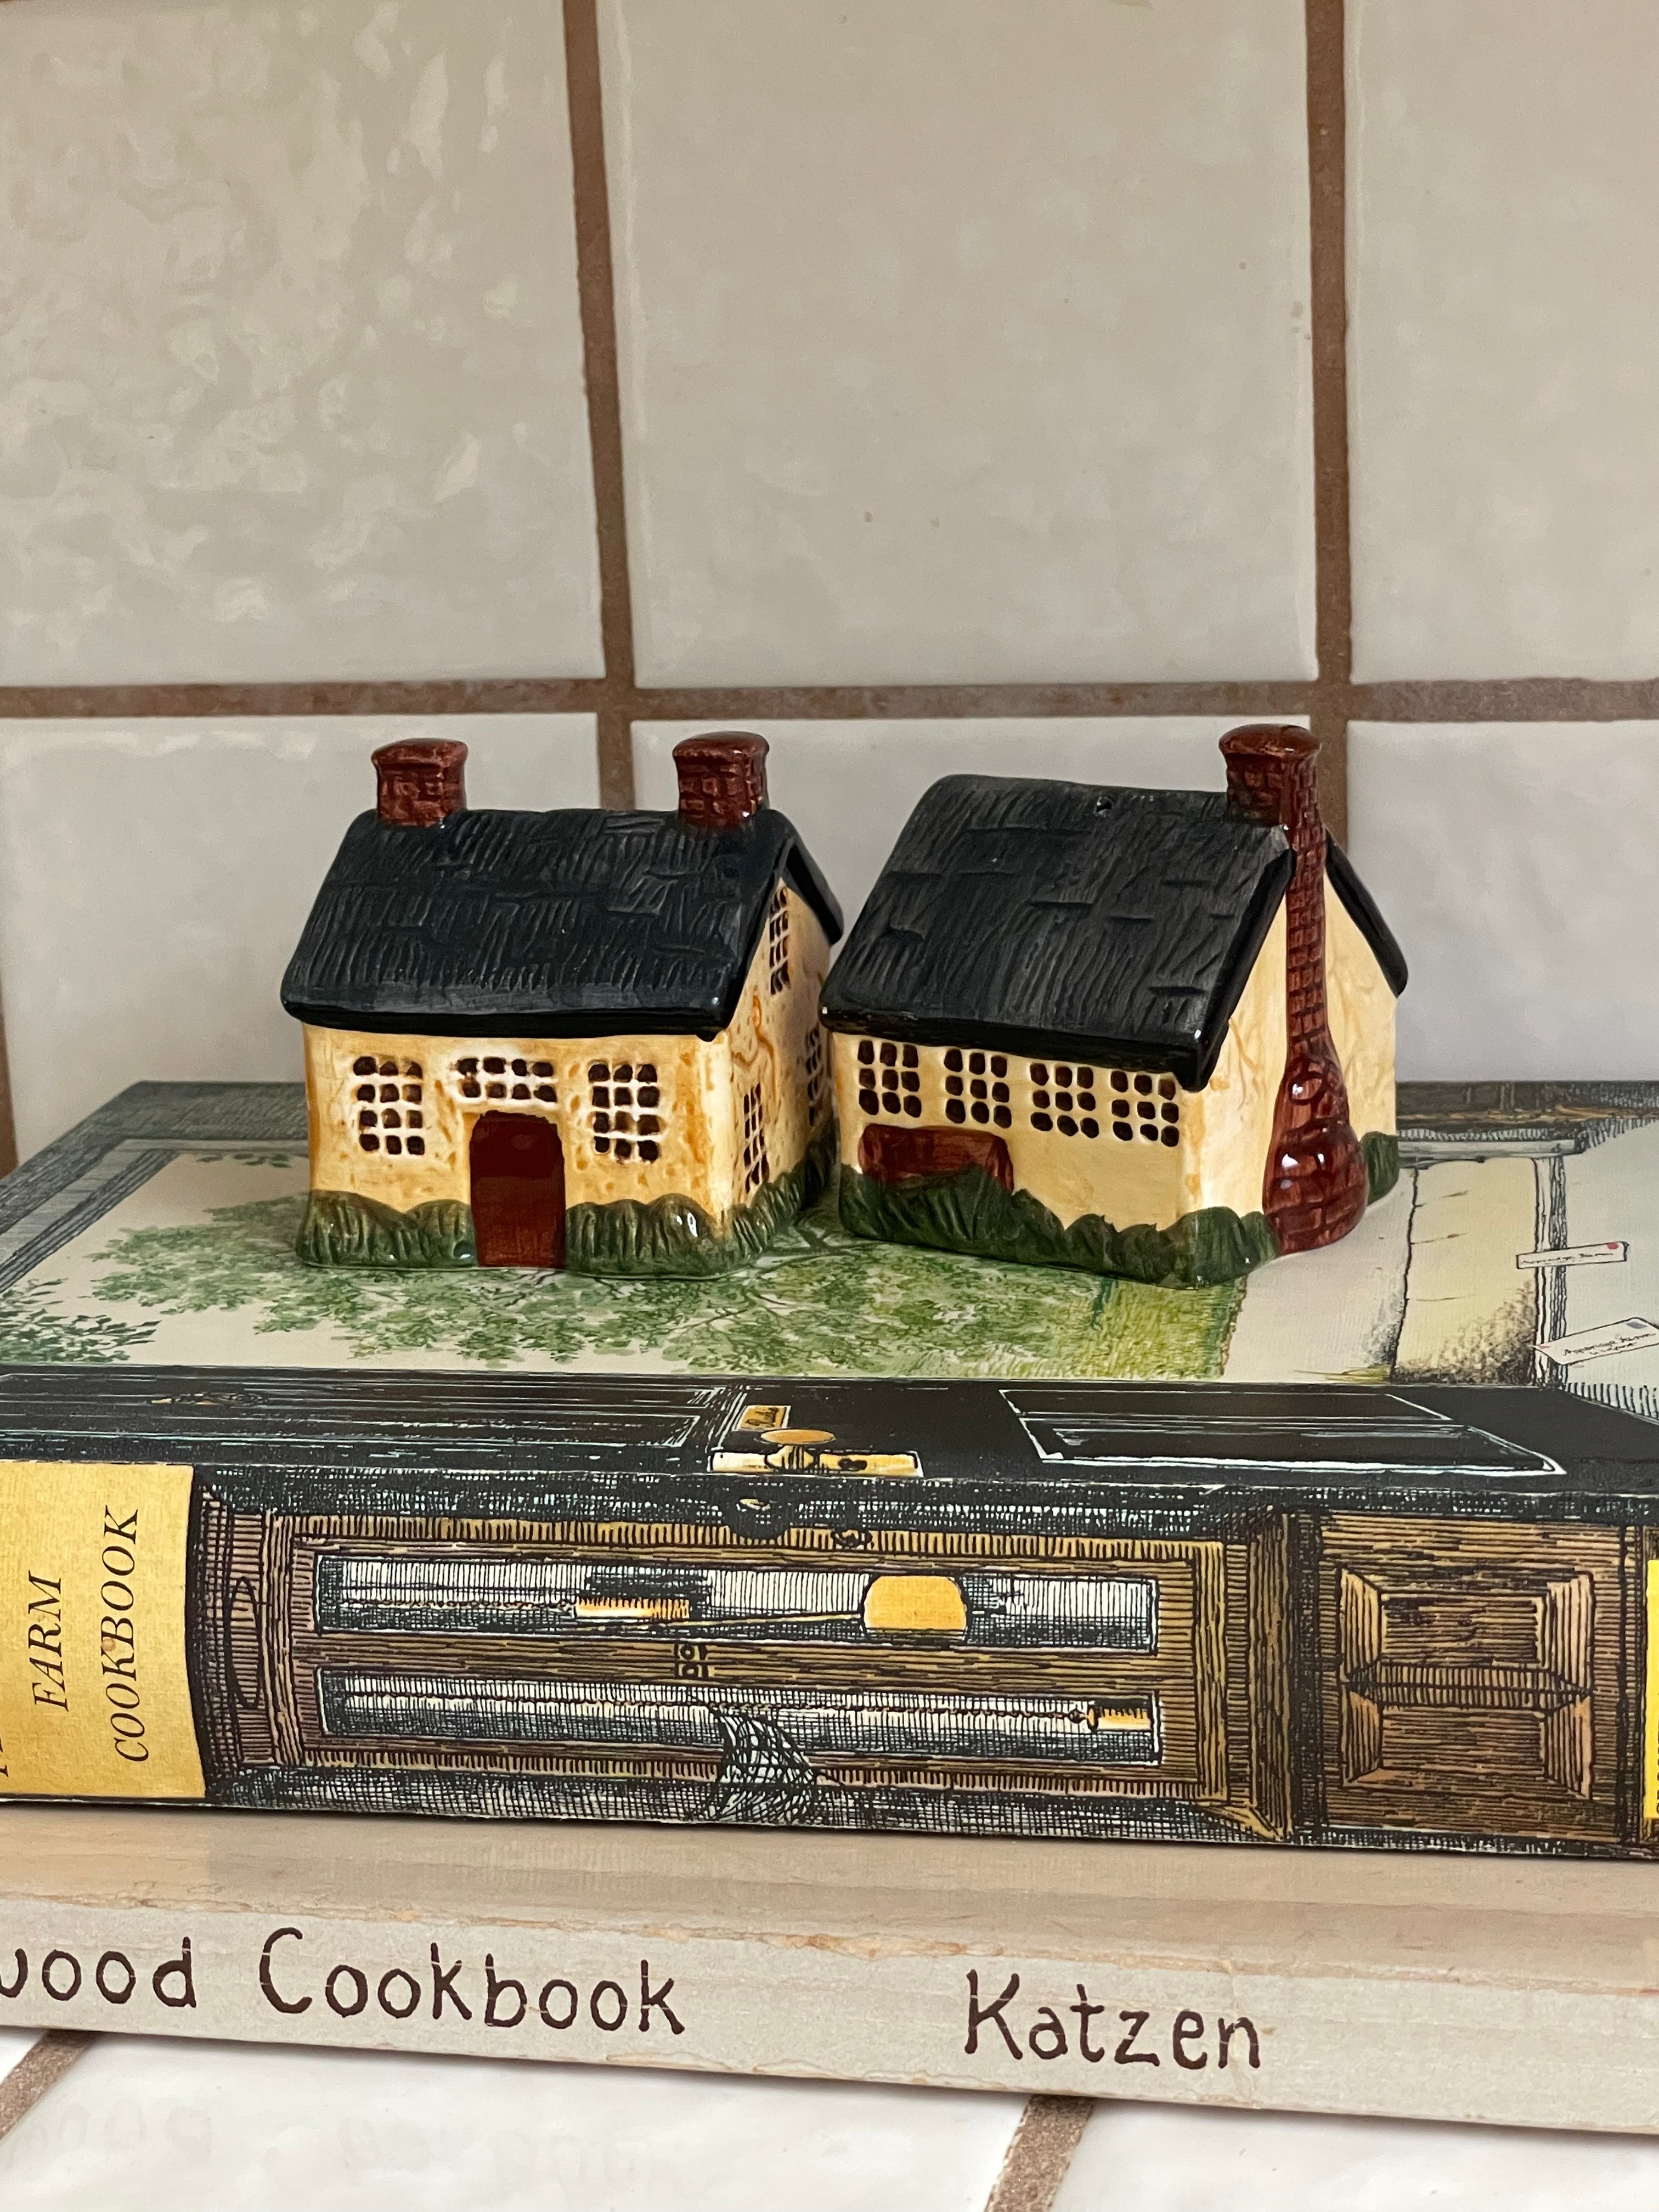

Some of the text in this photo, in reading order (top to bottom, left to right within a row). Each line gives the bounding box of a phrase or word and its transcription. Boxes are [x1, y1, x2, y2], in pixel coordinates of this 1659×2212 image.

[28, 1570, 69, 1712] FARM
[100, 1505, 149, 1762] COOKBOOK
[259, 1927, 685, 2035] Cookbook
[964, 1968, 1261, 2070] Katzen
